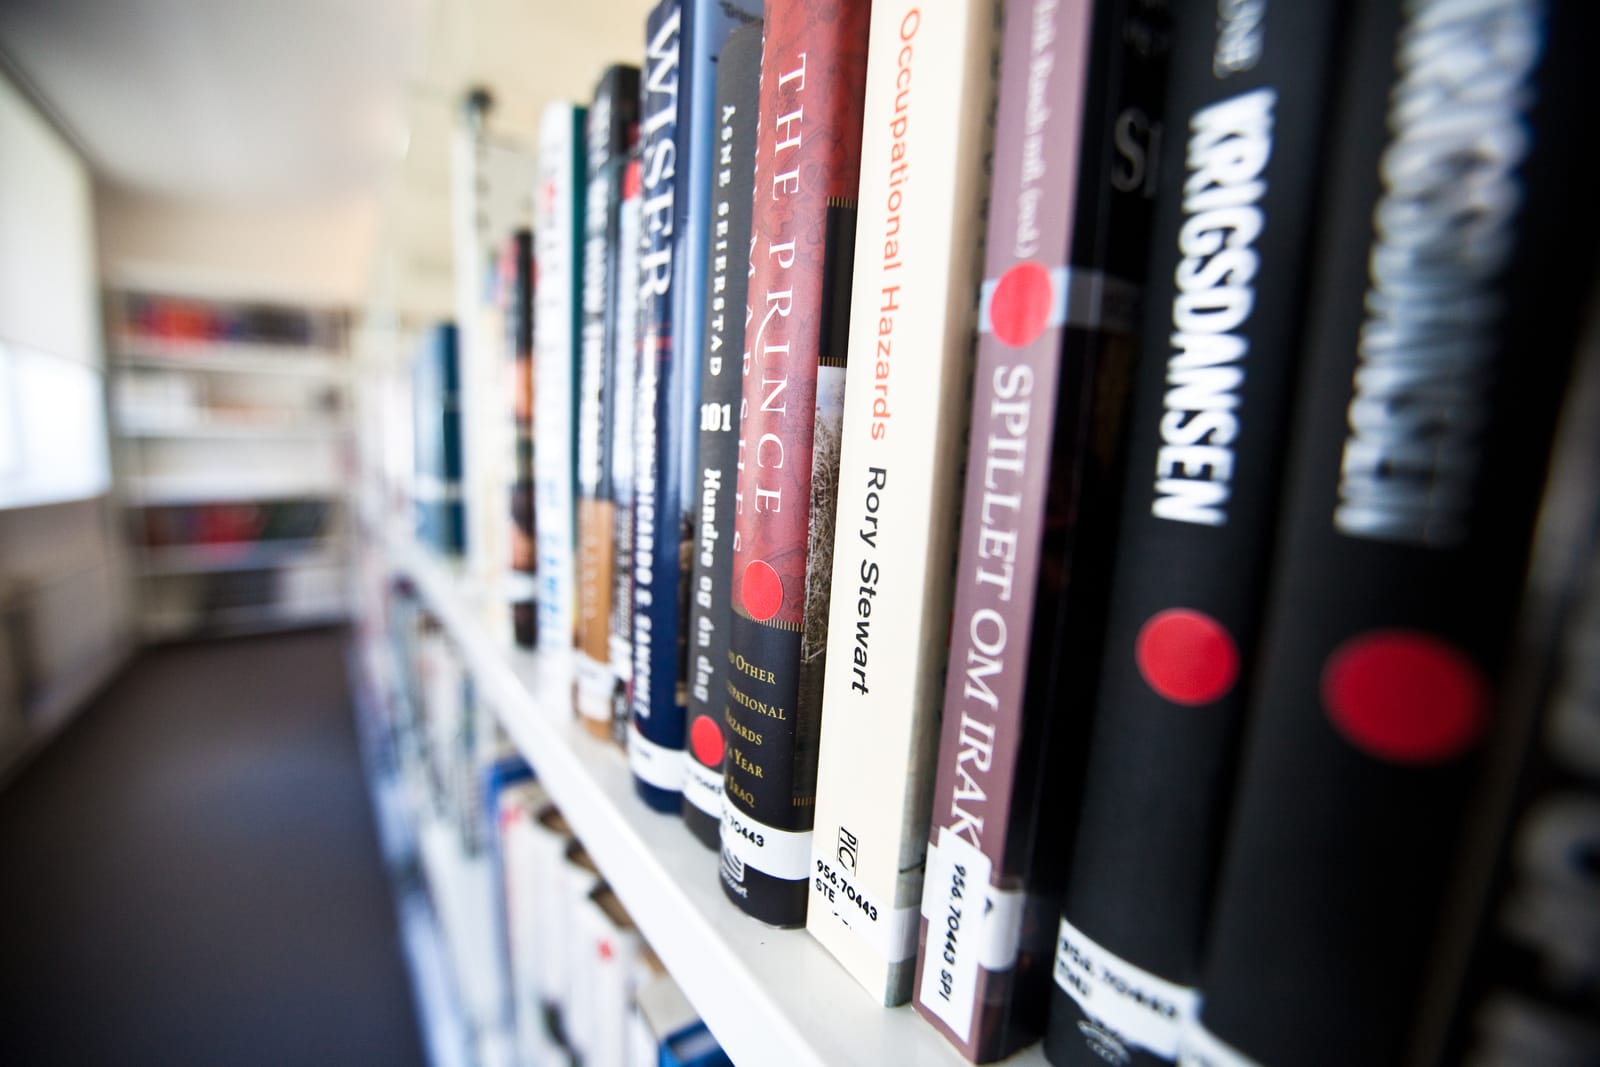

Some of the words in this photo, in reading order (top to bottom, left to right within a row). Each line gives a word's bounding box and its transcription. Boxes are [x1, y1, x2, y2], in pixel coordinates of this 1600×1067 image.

[641, 5, 682, 306] WISER
[772, 52, 807, 201] THE
[883, 8, 921, 271] Occupational
[709, 201, 731, 377] SEIERSTAD
[1151, 86, 1278, 527] KRIGSDANSEN
[755, 237, 797, 513] PRINCE
[871, 285, 901, 440] Hazards
[700, 402, 732, 432] 101
[701, 467, 722, 568] Hundre
[859, 466, 887, 549] Rory
[976, 363, 1034, 601] SPILLET
[696, 576, 713, 608] og
[696, 615, 716, 647] én
[851, 559, 879, 695] Stewart
[693, 655, 714, 702] dag
[728, 681, 787, 721] PATIONAL
[735, 654, 776, 685] OTHER
[963, 608, 1008, 713] OM
[735, 749, 764, 779] YEAR
[948, 711, 996, 850] IRAK
[815, 878, 836, 904] STE
[816, 859, 878, 921] 956.70443
[942, 863, 967, 965] 956.70443
[938, 968, 954, 1002] SPI
